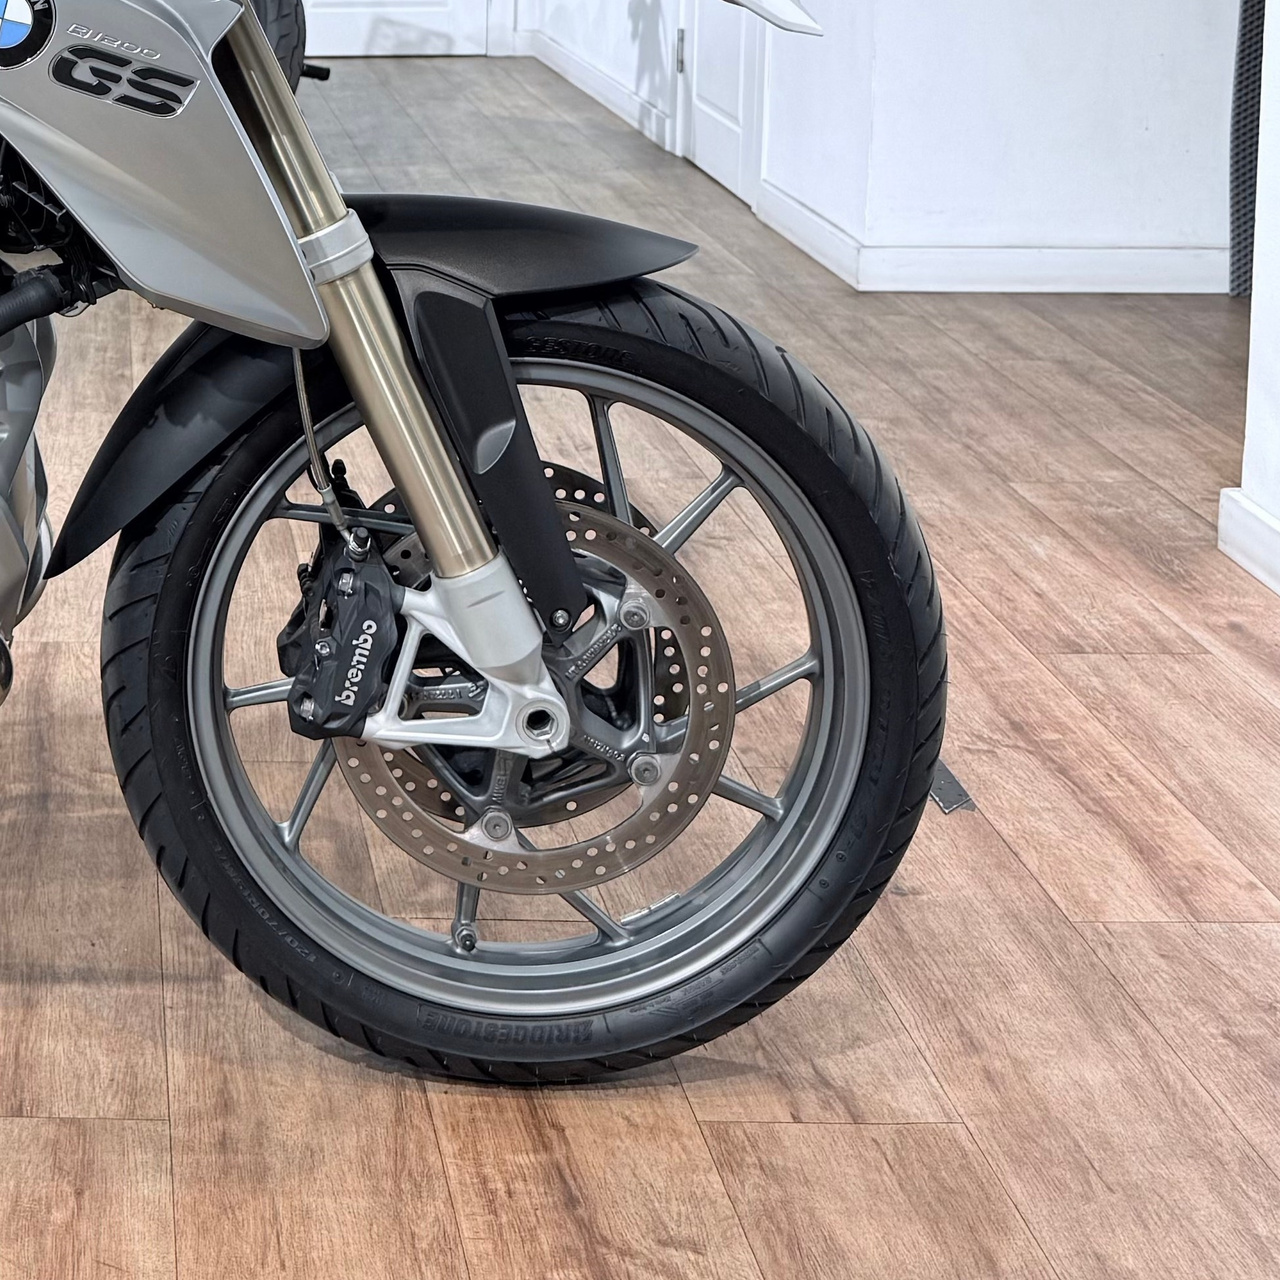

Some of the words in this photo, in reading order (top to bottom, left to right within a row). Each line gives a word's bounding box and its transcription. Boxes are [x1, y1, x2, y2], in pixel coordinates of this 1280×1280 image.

[66, 23, 162, 60] R1200
[50, 43, 198, 117] GS
[334, 619, 378, 707] brembo
[422, 1011, 594, 1045] BRIDGESTONE
